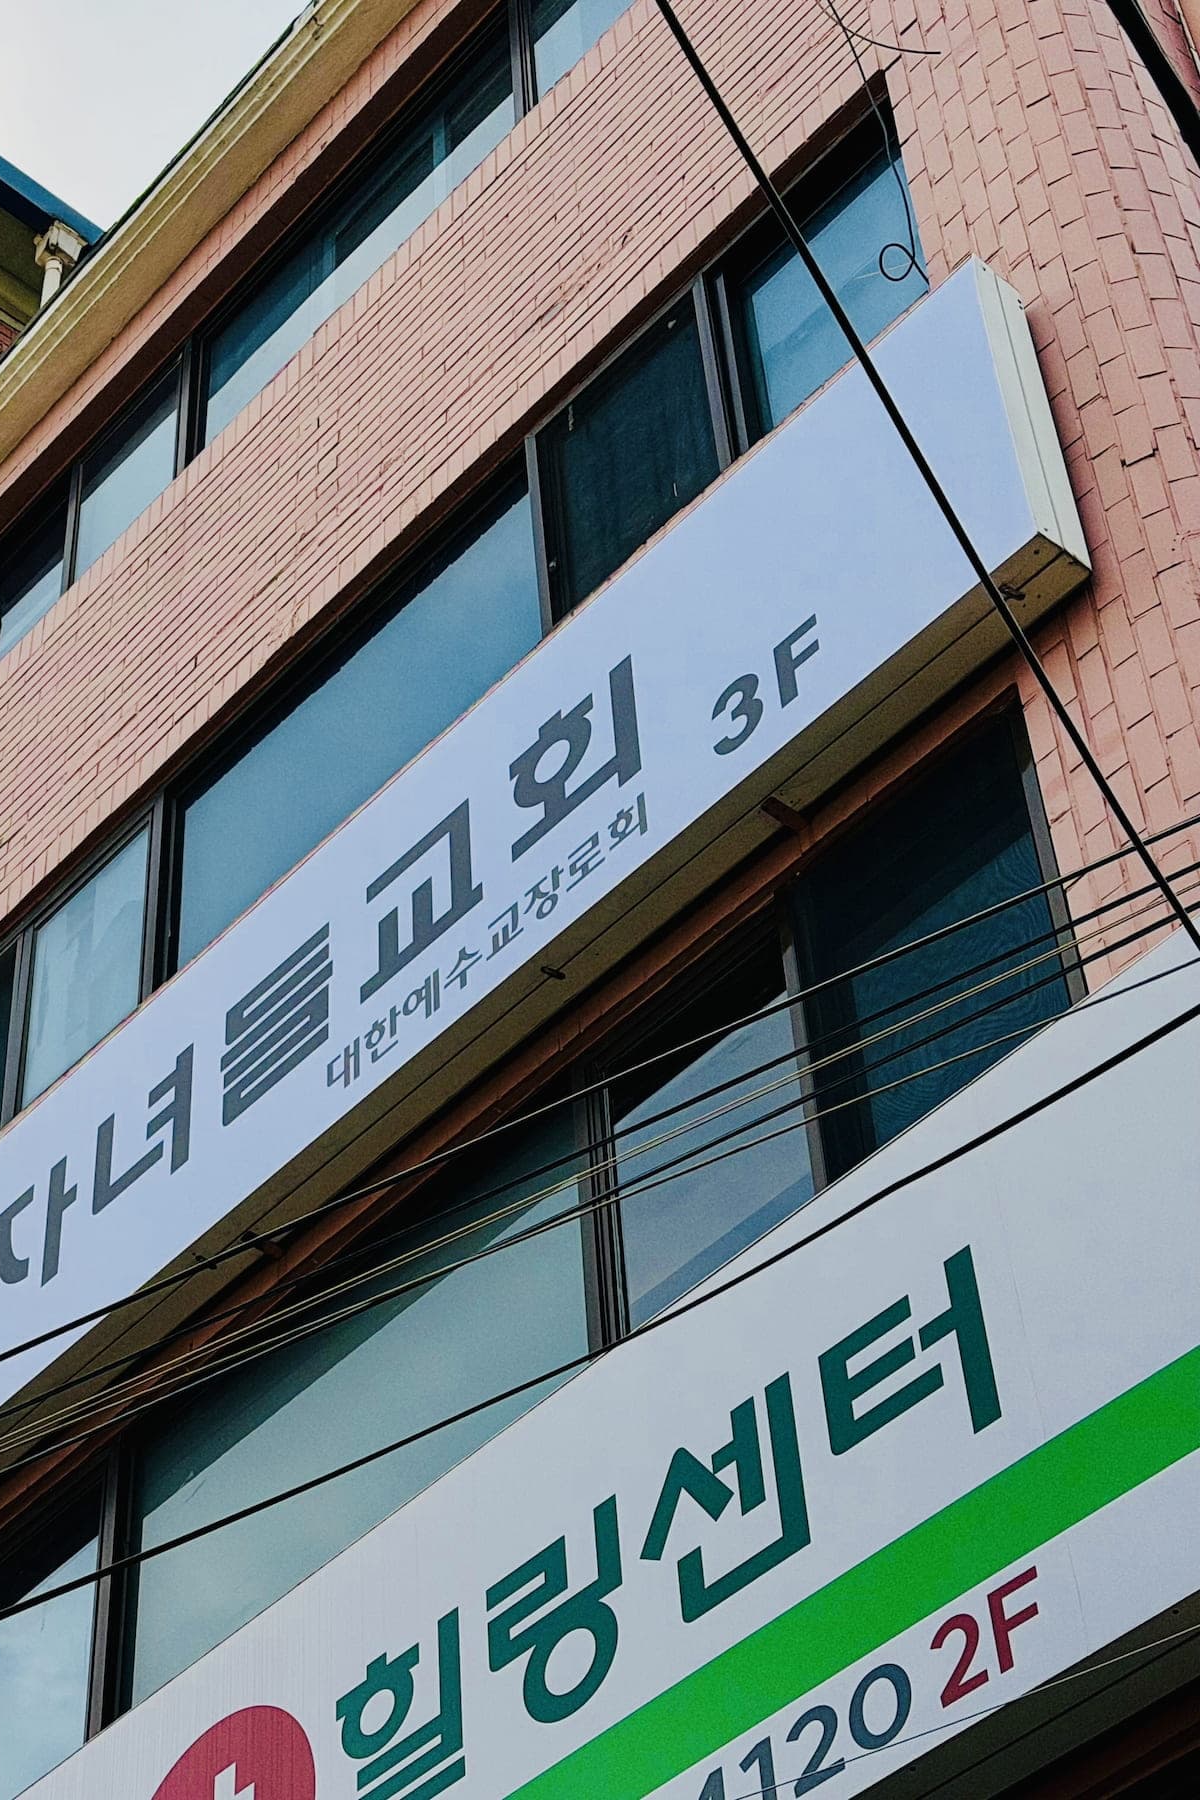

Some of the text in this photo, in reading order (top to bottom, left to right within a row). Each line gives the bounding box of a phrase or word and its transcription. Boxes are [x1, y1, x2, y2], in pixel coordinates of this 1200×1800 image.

[710, 611, 823, 757] 3F
[325, 793, 650, 1090] 대한예수교장로회
[335, 1243, 1002, 1800] 힐링센터
[929, 1564, 1040, 1709] 2F
